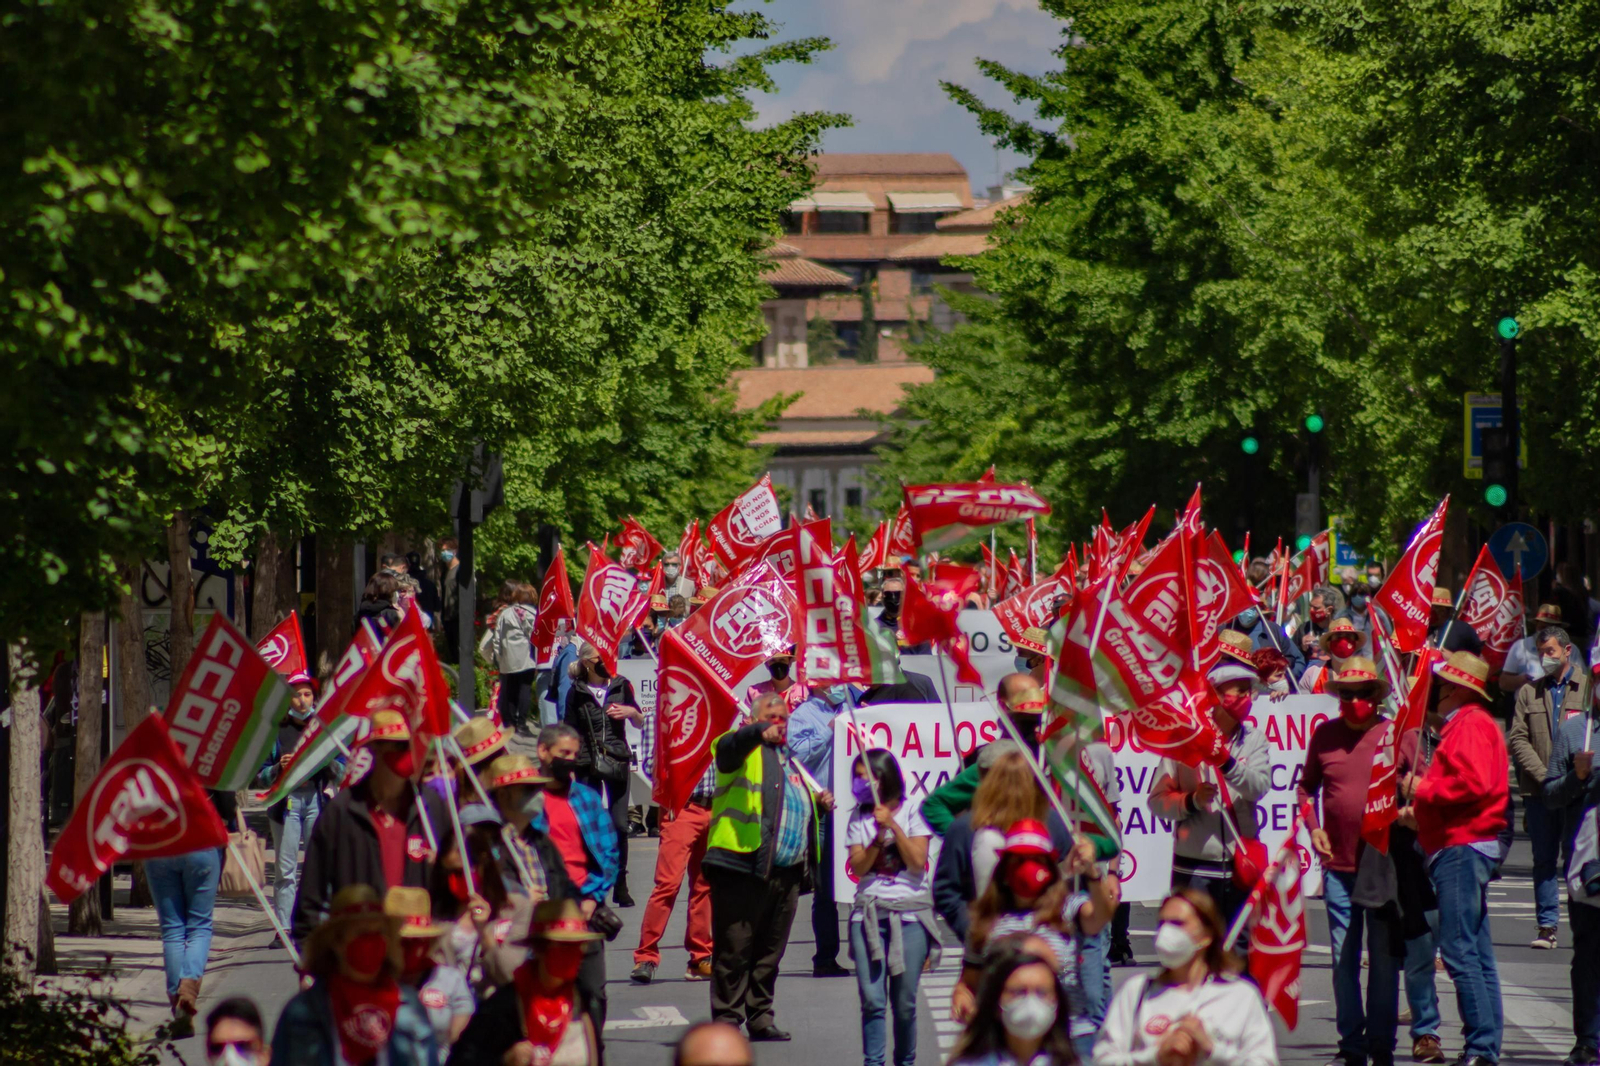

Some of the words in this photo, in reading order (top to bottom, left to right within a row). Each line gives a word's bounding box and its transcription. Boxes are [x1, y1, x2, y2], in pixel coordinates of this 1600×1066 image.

[741, 501, 752, 511] NO
[752, 490, 767, 503] NOS
[745, 498, 771, 517] VAMOS
[753, 514, 779, 532] ECHAN
[755, 508, 770, 521] NOS
[1104, 627, 1155, 695] Granada
[847, 721, 893, 757] NO
[901, 722, 924, 758] A
[934, 720, 998, 758] LOS
